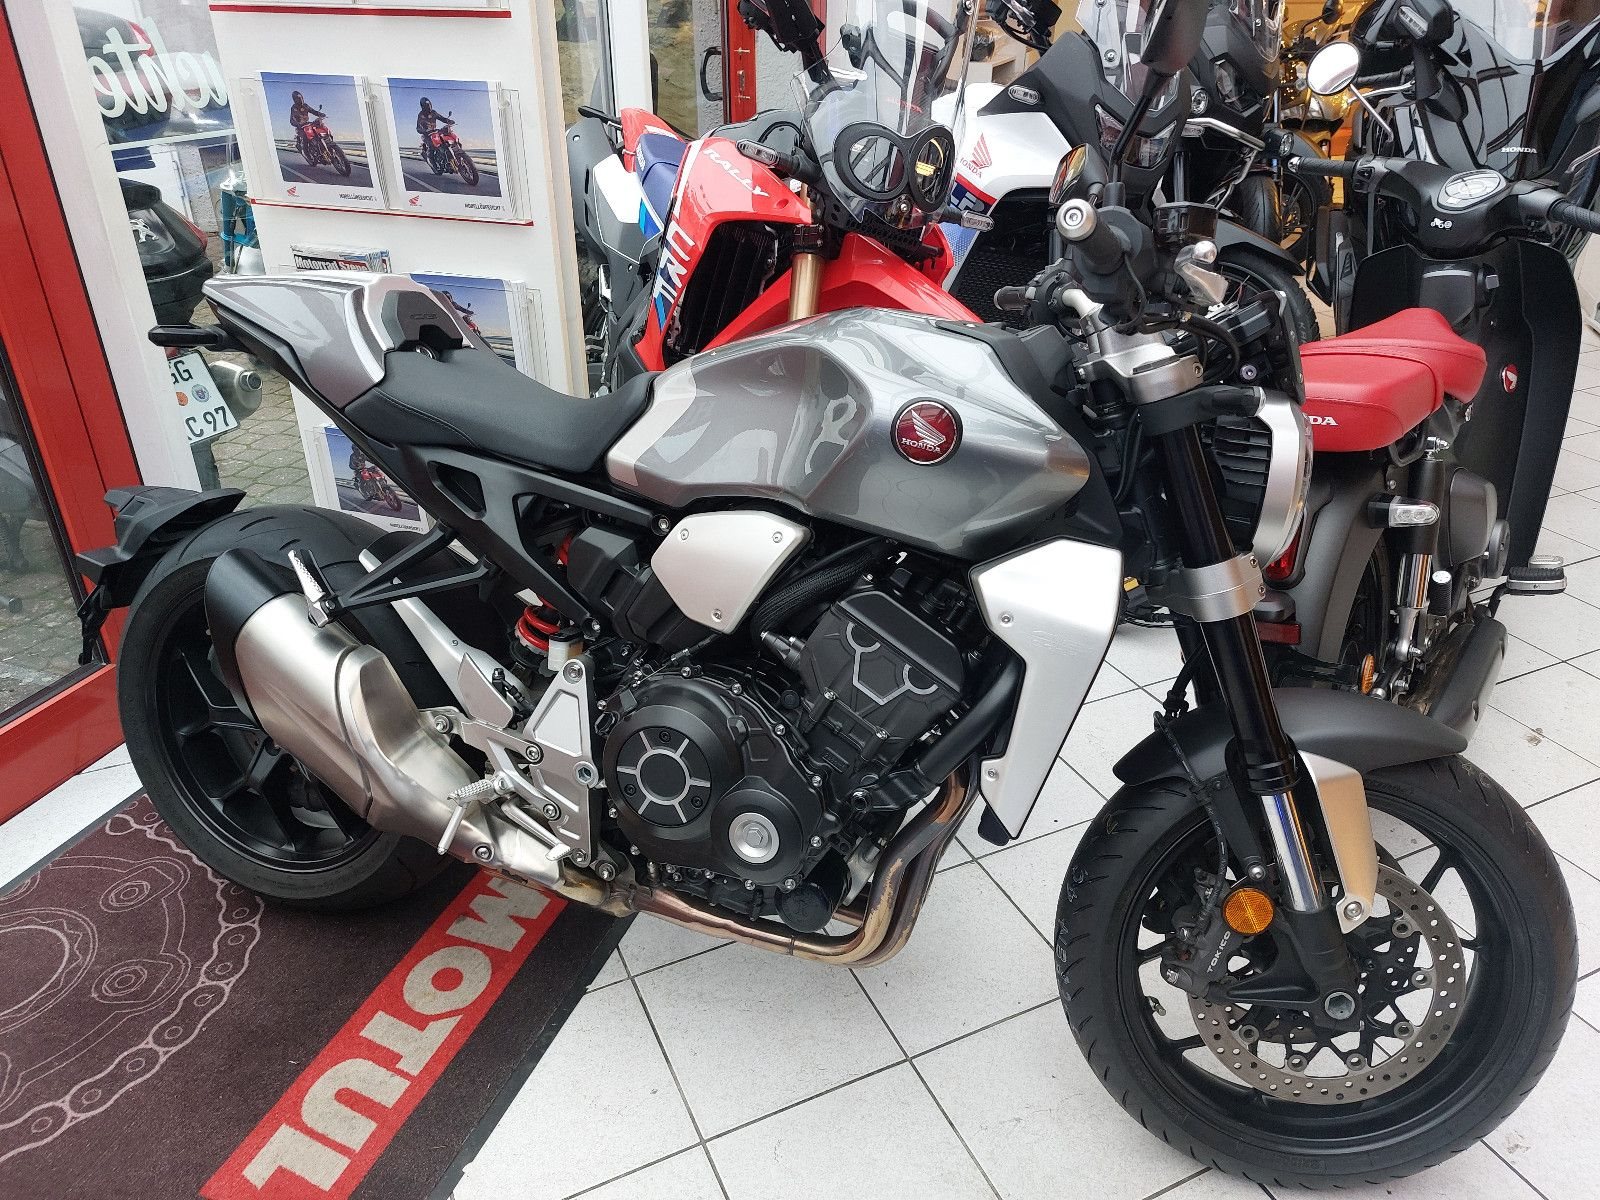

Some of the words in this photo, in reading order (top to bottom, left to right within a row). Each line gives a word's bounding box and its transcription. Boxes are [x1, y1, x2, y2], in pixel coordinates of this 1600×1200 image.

[1501, 146, 1538, 154] HONDA
[704, 149, 770, 197] RALLY
[294, 256, 339, 271] Motorrad
[338, 261, 368, 272] Szene
[202, 405, 230, 432] 97
[901, 437, 943, 455] HONDA
[1206, 930, 1232, 974] TOKICO
[241, 876, 551, 1192] MOTUL
